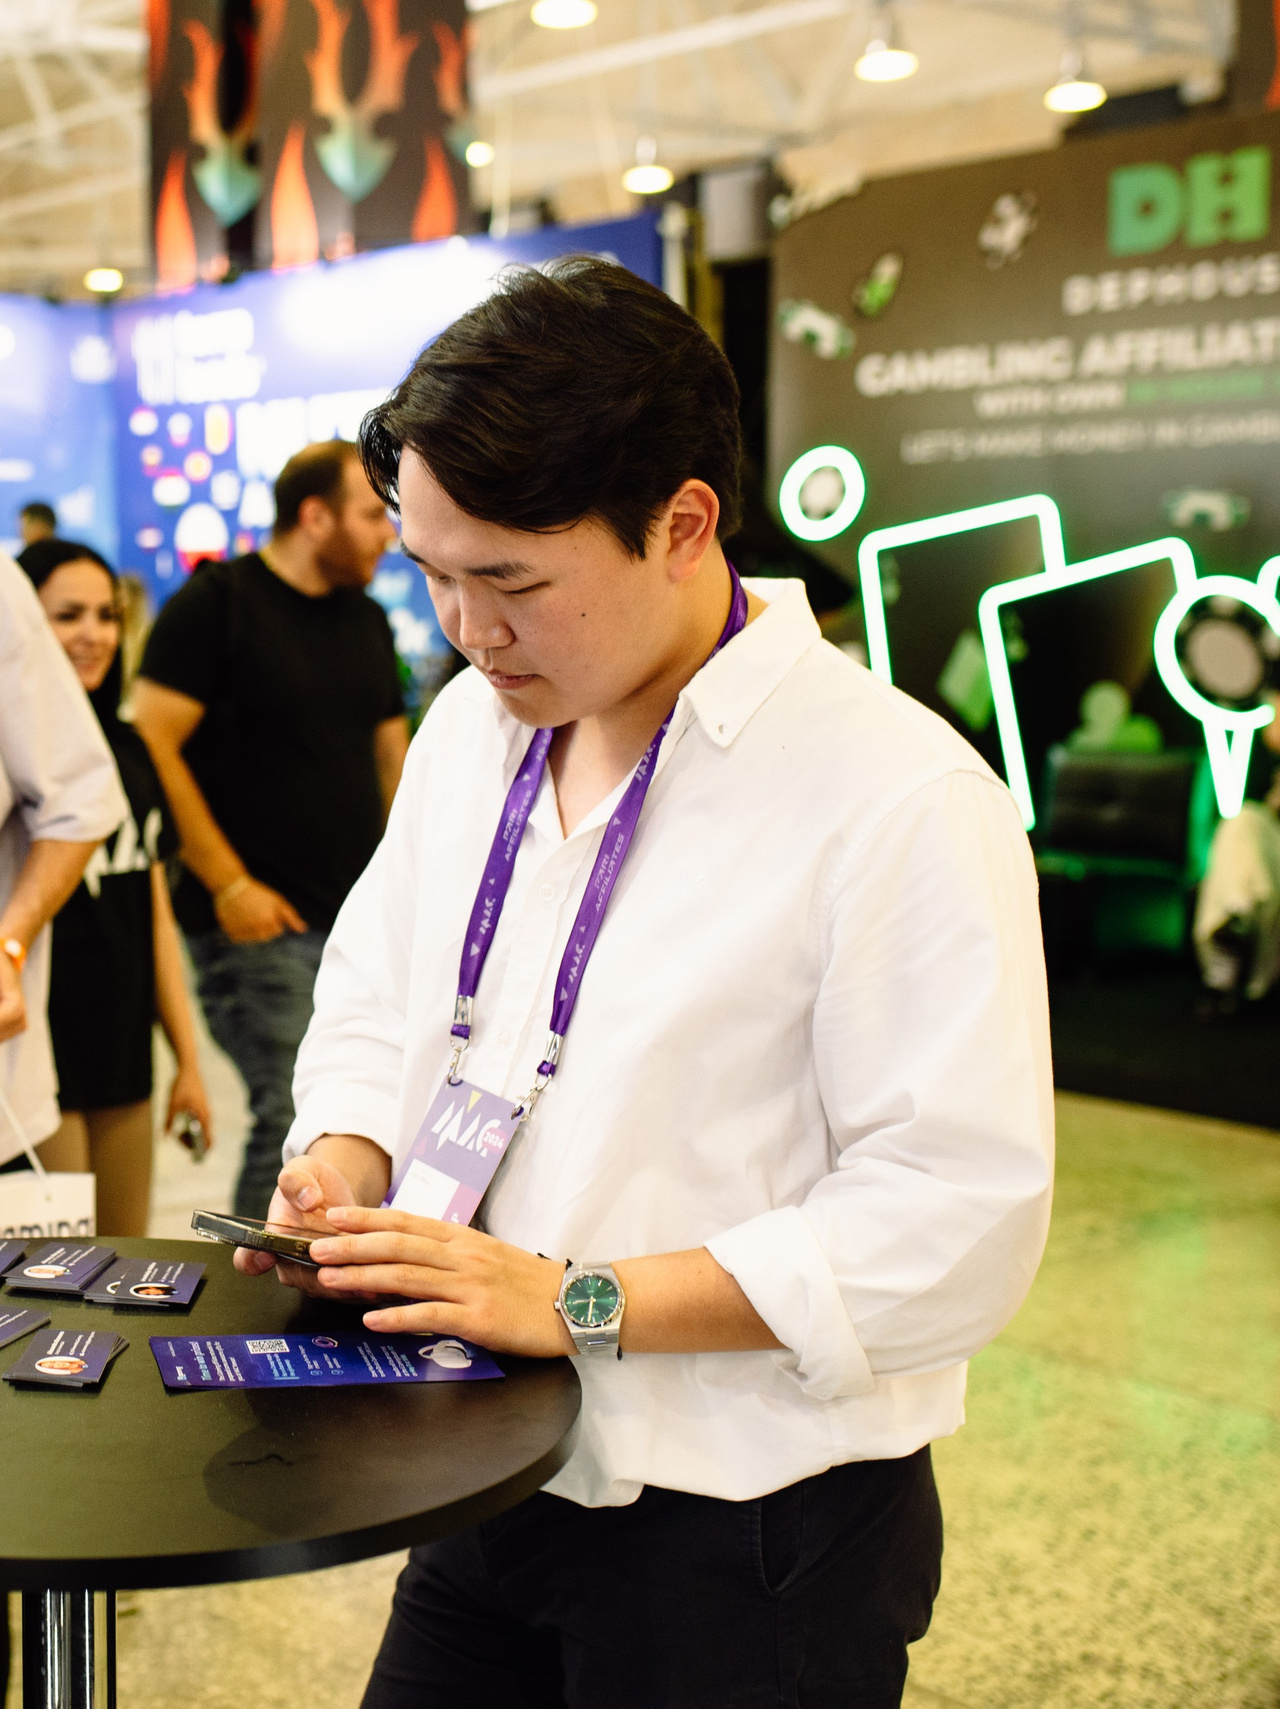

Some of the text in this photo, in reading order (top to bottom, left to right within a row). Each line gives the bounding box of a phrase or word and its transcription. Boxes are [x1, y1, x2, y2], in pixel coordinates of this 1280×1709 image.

[1106, 143, 1273, 258] DH
[855, 336, 1074, 397] GAMBLING
[504, 789, 533, 862] AFFILIATES
[594, 832, 625, 912] AFFILIATES
[483, 1131, 505, 1150] 2024
